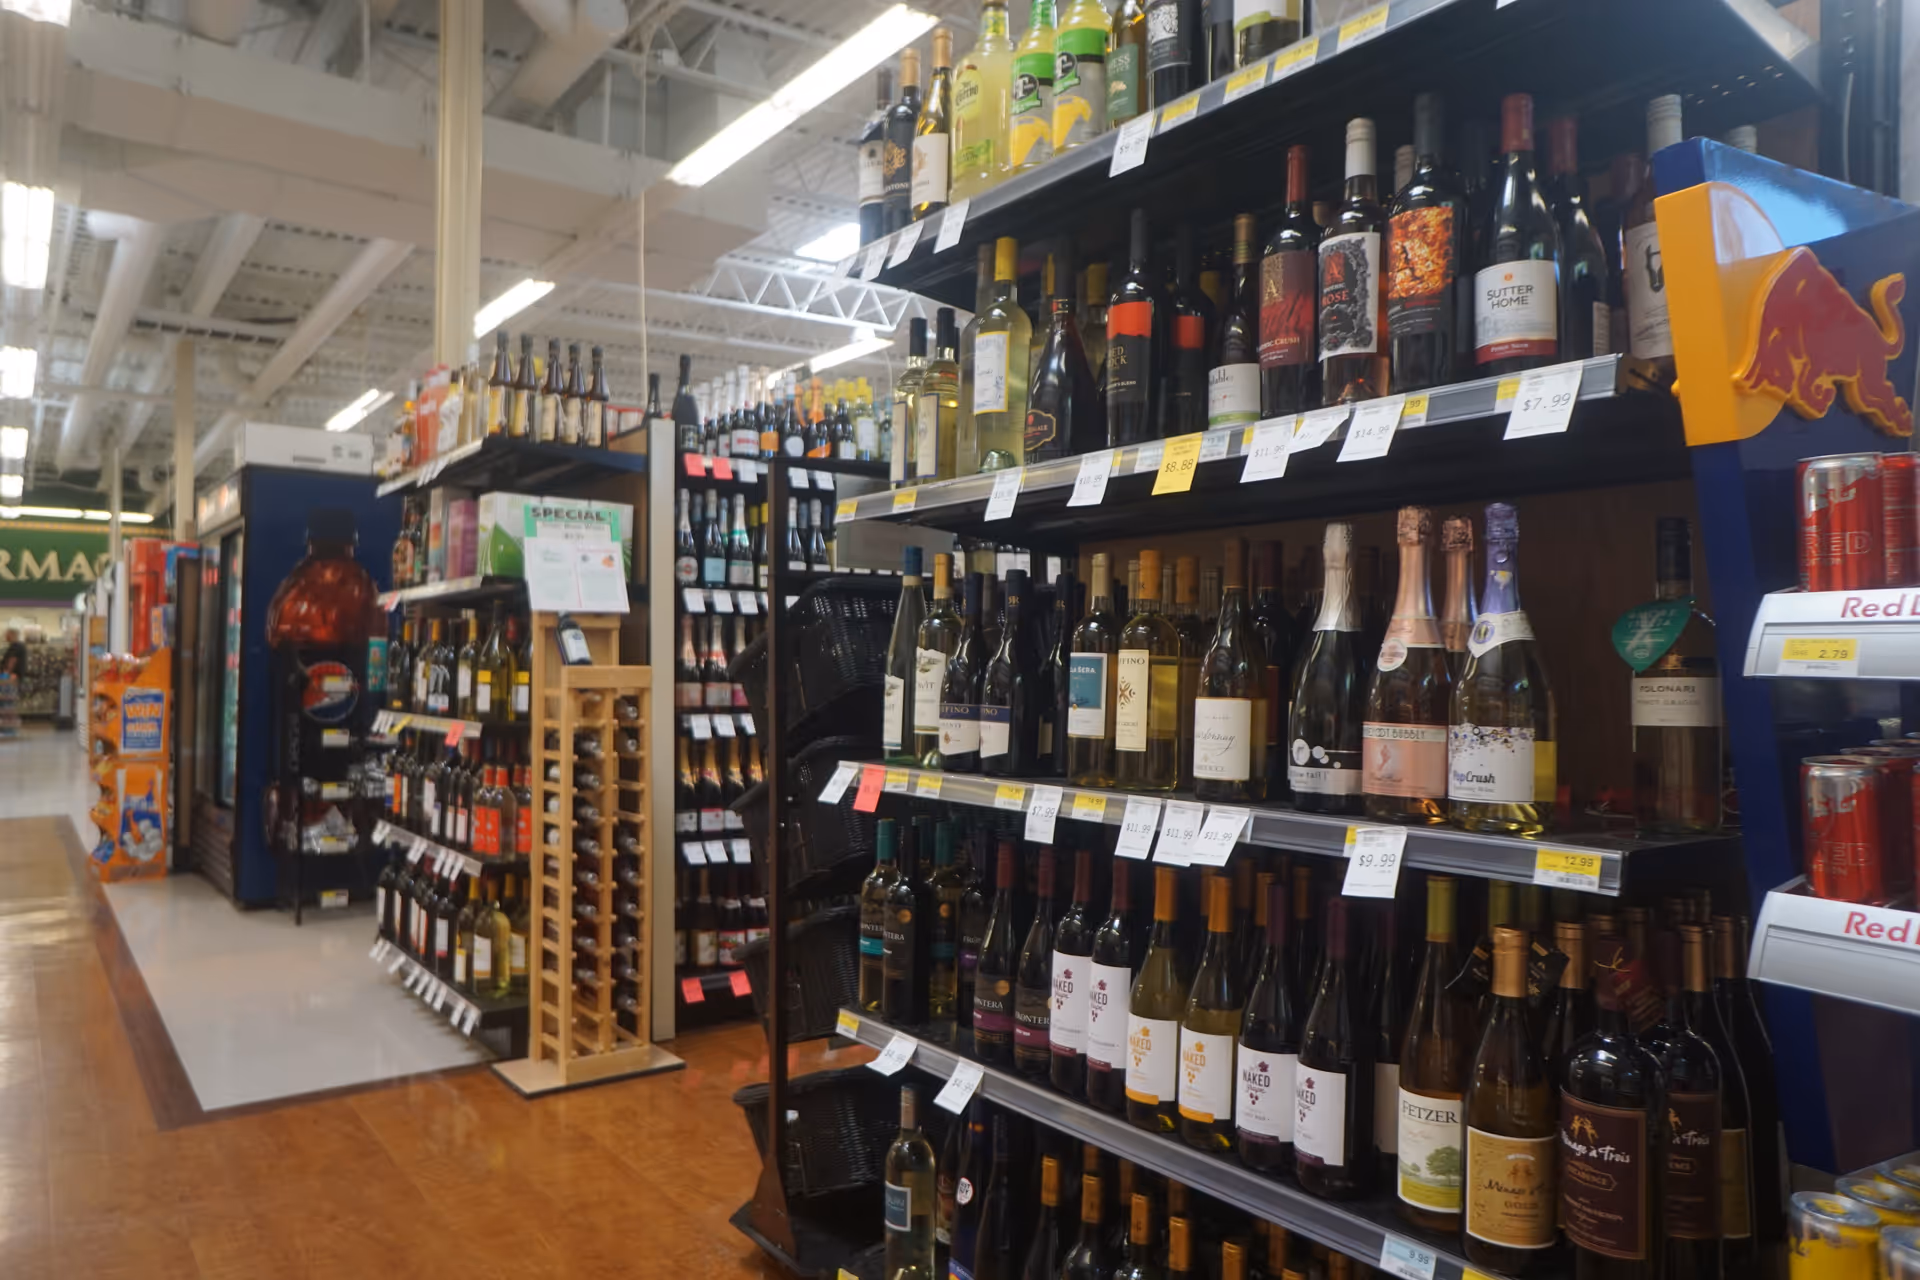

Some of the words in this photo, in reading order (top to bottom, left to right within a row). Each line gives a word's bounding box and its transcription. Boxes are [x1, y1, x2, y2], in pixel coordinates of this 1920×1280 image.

[1486, 285, 1534, 301] SUTTER
[1491, 295, 1529, 309] HOME
[1523, 392, 1572, 412] $7.99
[1164, 458, 1195, 474] $8.88
[1841, 593, 1908, 618] Red
[1818, 649, 1850, 660] 2.79
[1031, 805, 1056, 819] $7.99
[1126, 822, 1151, 835] $11.99
[1166, 828, 1193, 841] $11.99
[1359, 853, 1397, 868] $9.99
[1564, 856, 1595, 867] 12.99
[1844, 910, 1912, 943] Red
[1242, 1068, 1271, 1088] NAKED
[1402, 1100, 1460, 1124] FETZER
[1681, 1130, 1710, 1146] Trois
[1598, 1145, 1631, 1163] Trois
[1408, 1249, 1430, 1266] 9.99
